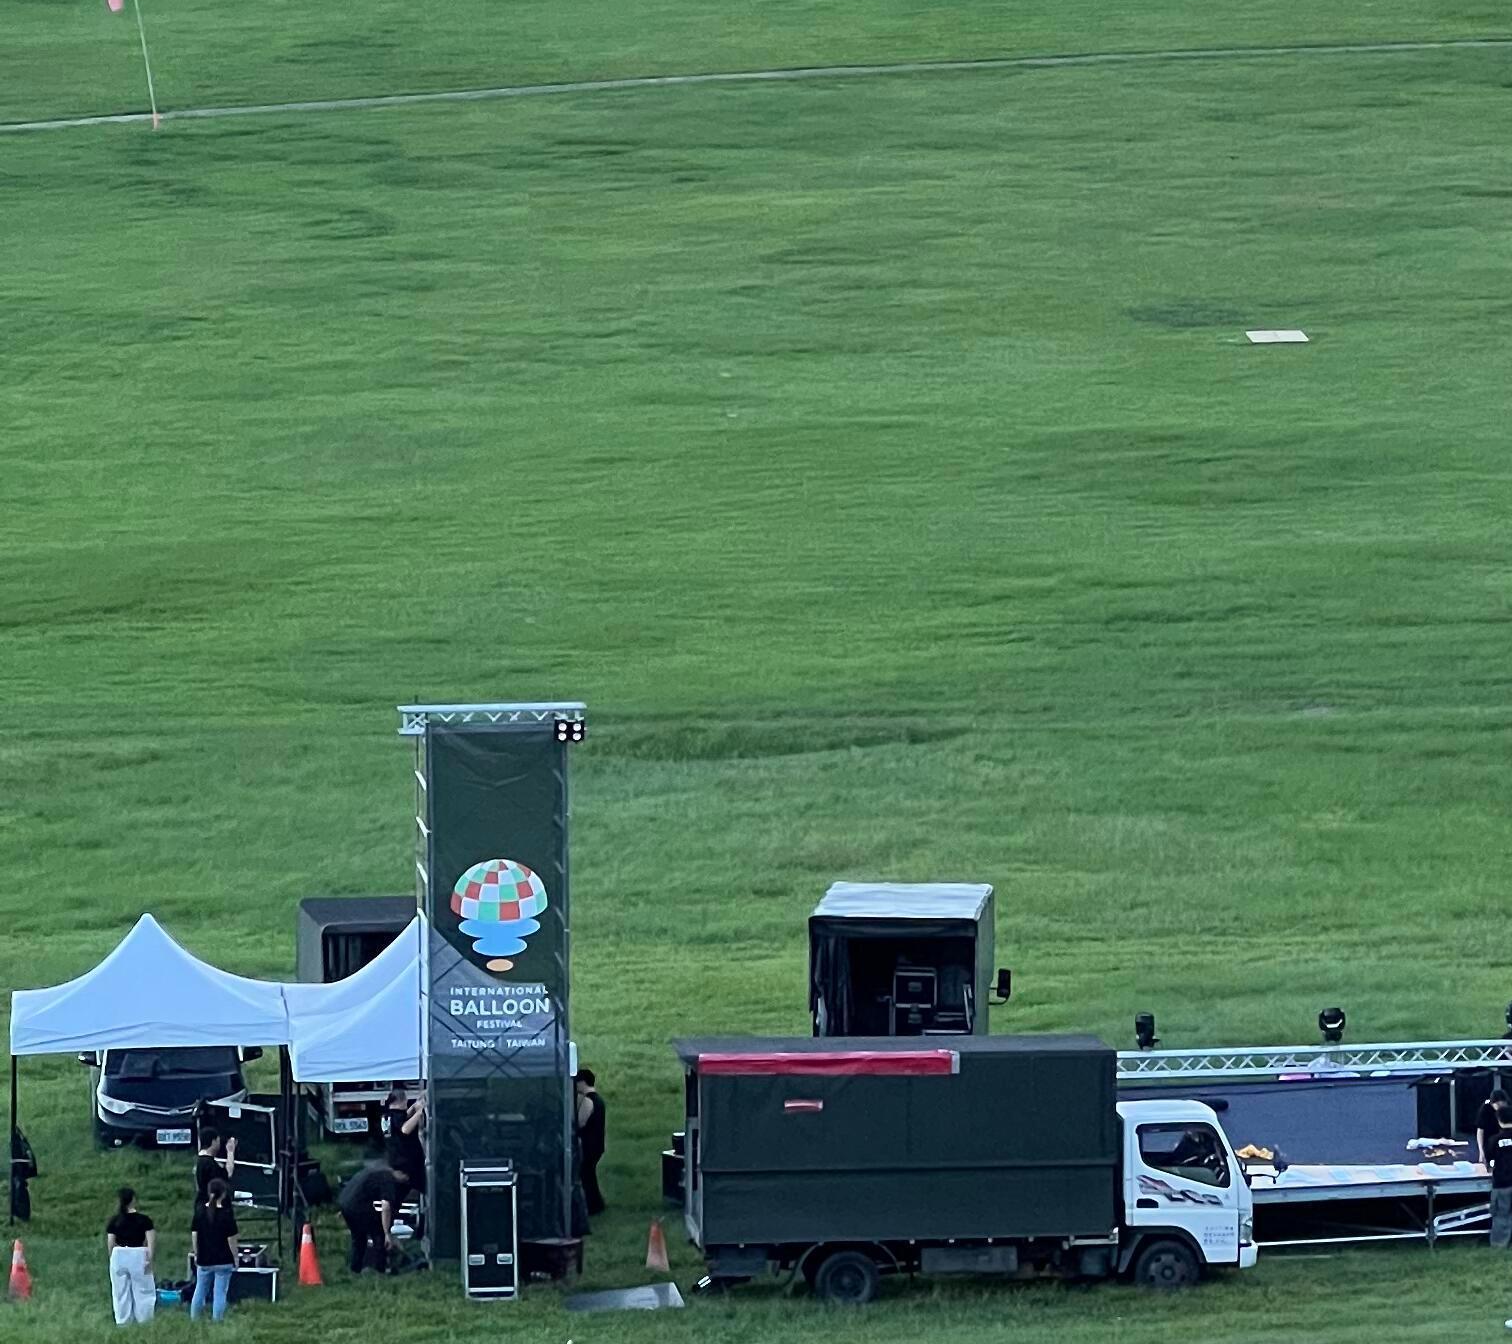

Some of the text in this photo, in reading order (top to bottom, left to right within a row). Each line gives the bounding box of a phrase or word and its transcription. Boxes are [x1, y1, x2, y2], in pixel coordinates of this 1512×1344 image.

[450, 986, 549, 996] INTERNATIONAL
[450, 997, 550, 1016] BALLOON
[476, 1019, 522, 1029] FESTIVAL
[451, 1038, 546, 1049] TAITUNG TAIWAN
